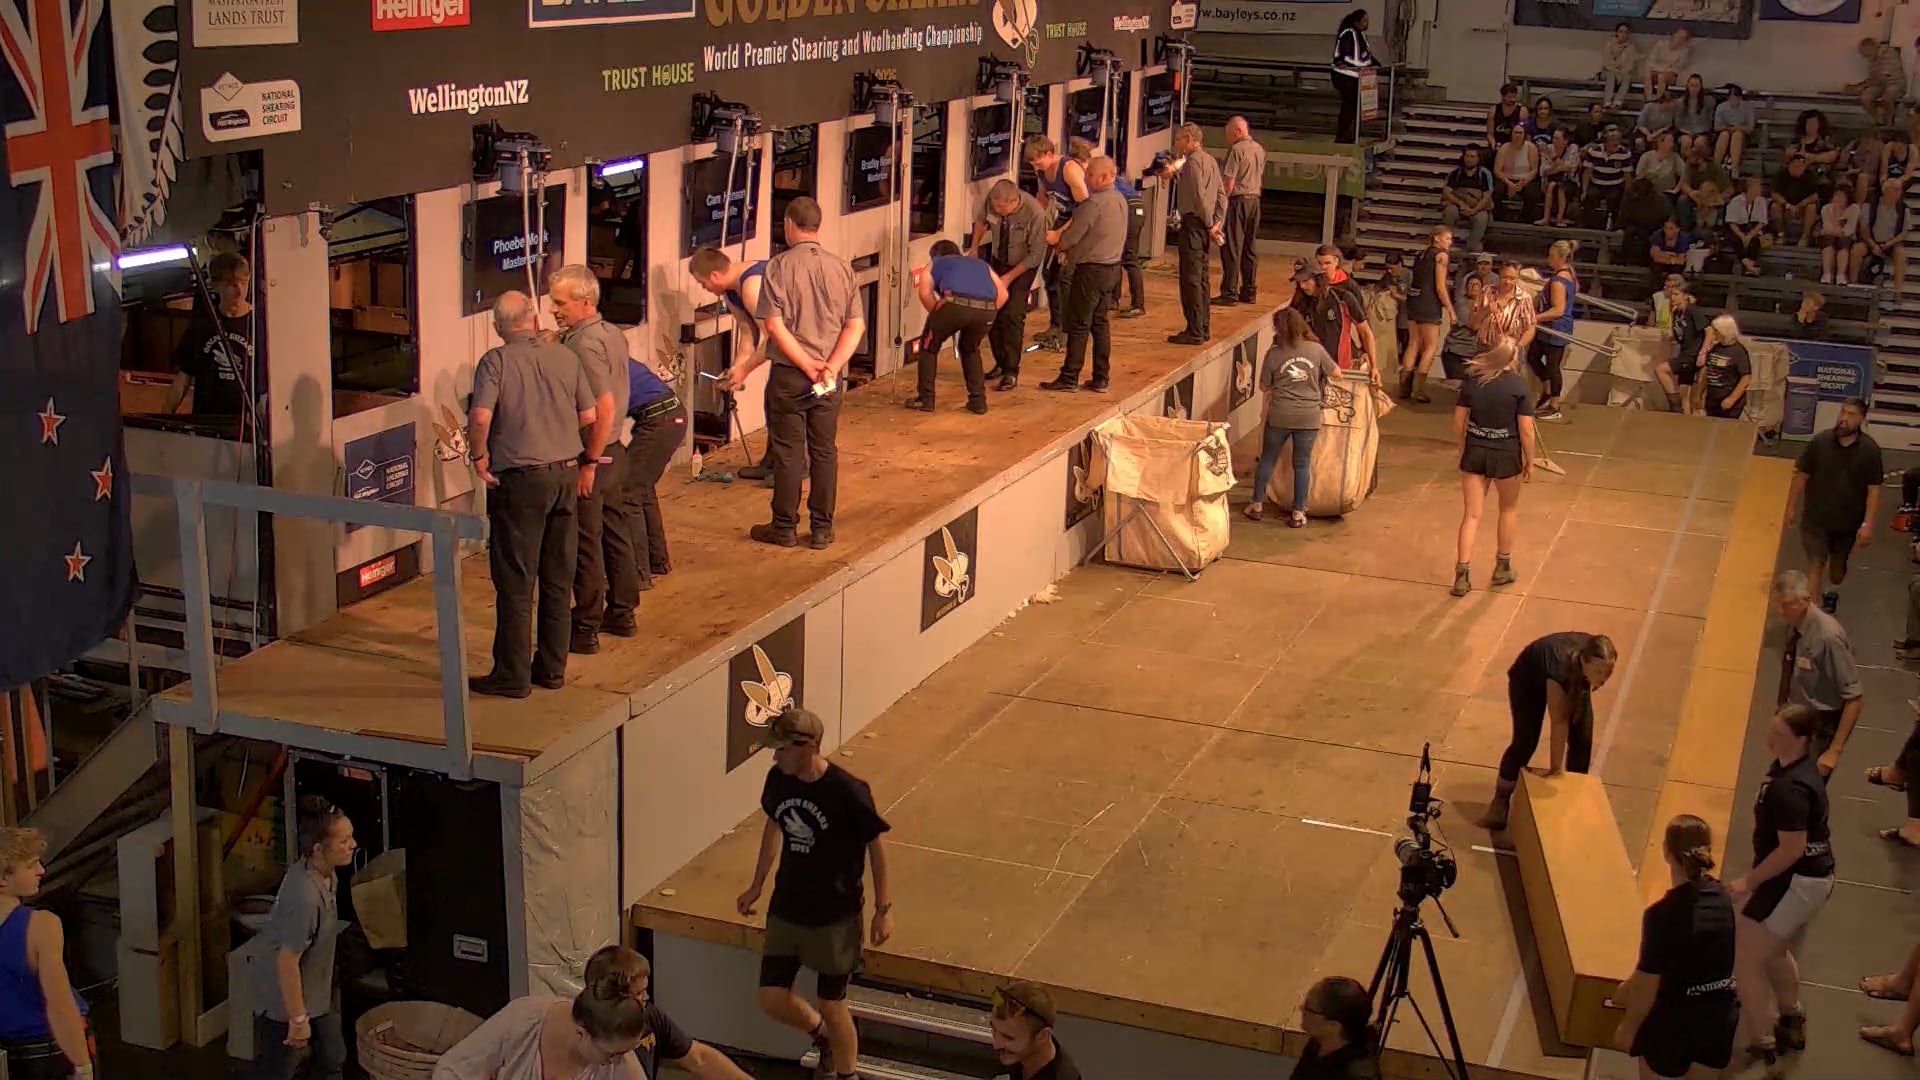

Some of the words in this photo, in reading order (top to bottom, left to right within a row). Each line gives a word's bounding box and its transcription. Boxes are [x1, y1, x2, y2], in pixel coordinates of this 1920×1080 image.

[208, 11, 247, 26] LANDS
[250, 10, 284, 24] TRUST
[704, 45, 740, 72] World
[744, 41, 788, 67] Premier
[792, 36, 840, 62] Shearing
[841, 31, 860, 56] and
[862, 28, 923, 53] Woolhandling
[925, 20, 982, 49] Championship
[602, 66, 647, 92] TRUST
[408, 79, 529, 115] WellingtonNZ
[493, 235, 526, 255] Phoebe
[475, 289, 481, 304] 1
